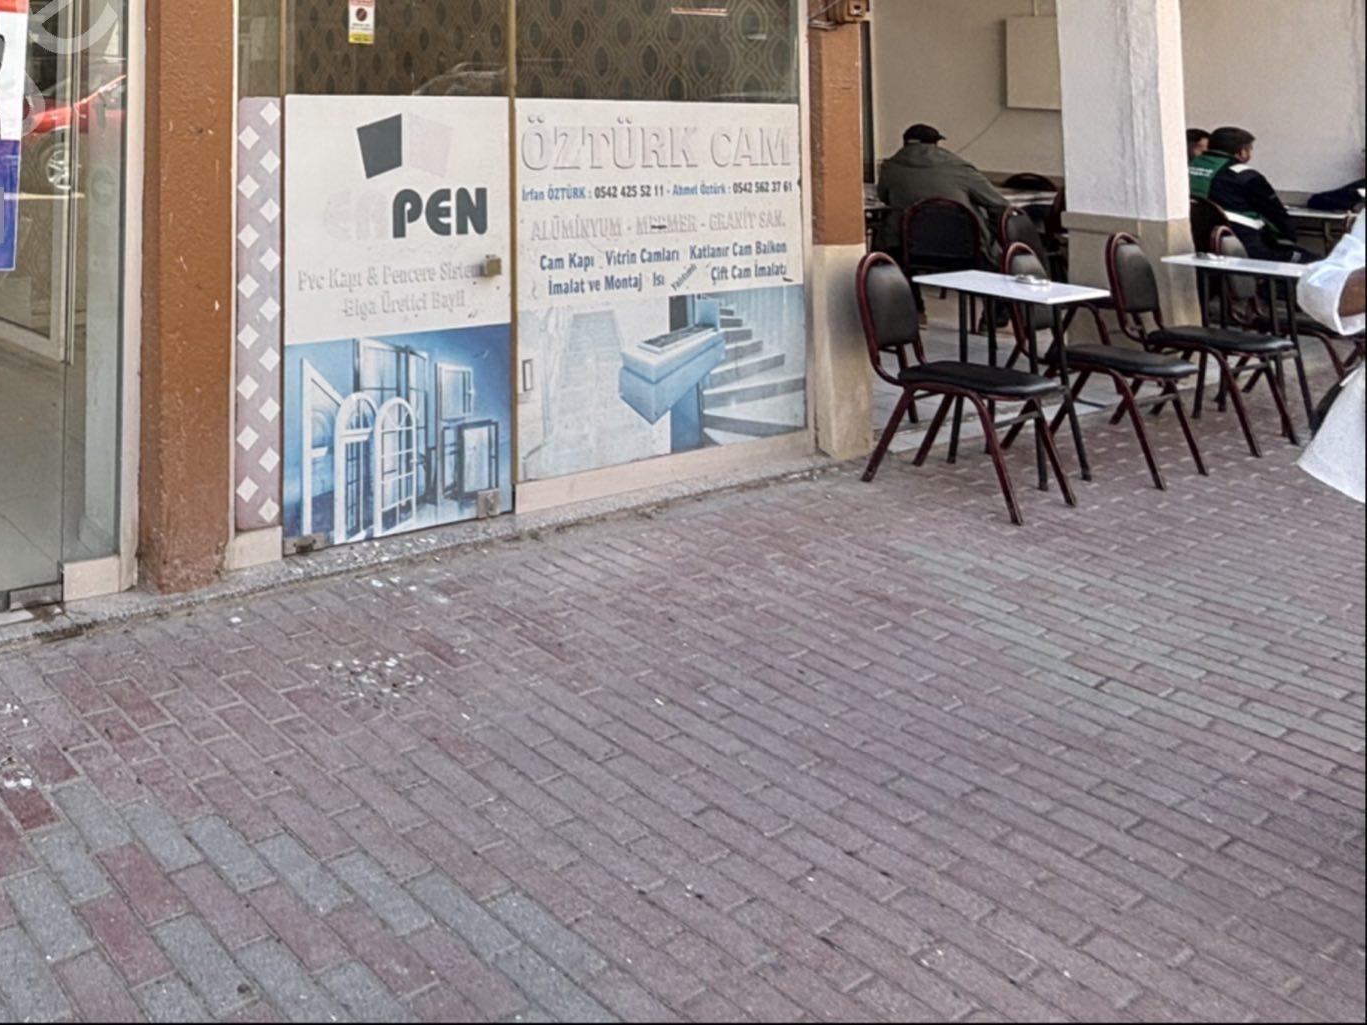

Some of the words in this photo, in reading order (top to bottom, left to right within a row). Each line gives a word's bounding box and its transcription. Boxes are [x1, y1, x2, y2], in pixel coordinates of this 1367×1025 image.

[521, 115, 698, 170] ÖZTÜRK
[711, 127, 791, 168] CAM
[522, 184, 545, 201] İrfan
[547, 183, 586, 200] ÖZTÜRK
[594, 185, 618, 198] 0542
[620, 184, 638, 198] 425
[640, 184, 652, 197] 52
[654, 184, 664, 197] 11
[732, 181, 753, 194] 0542
[771, 181, 781, 193] 37
[783, 181, 793, 192] 61
[539, 254, 565, 271] Cam
[568, 252, 595, 272] Kapı
[605, 249, 637, 266] Vitrin
[639, 247, 679, 264] Camları
[689, 244, 730, 260] Katlanır
[732, 241, 753, 257] Cam
[755, 240, 787, 255] Balkon
[548, 275, 586, 296] İmalat
[589, 278, 601, 292] ve
[604, 273, 643, 293] Montaj
[711, 265, 729, 287] Çift
[731, 264, 752, 280] Cam
[754, 259, 787, 278] İmalatı
